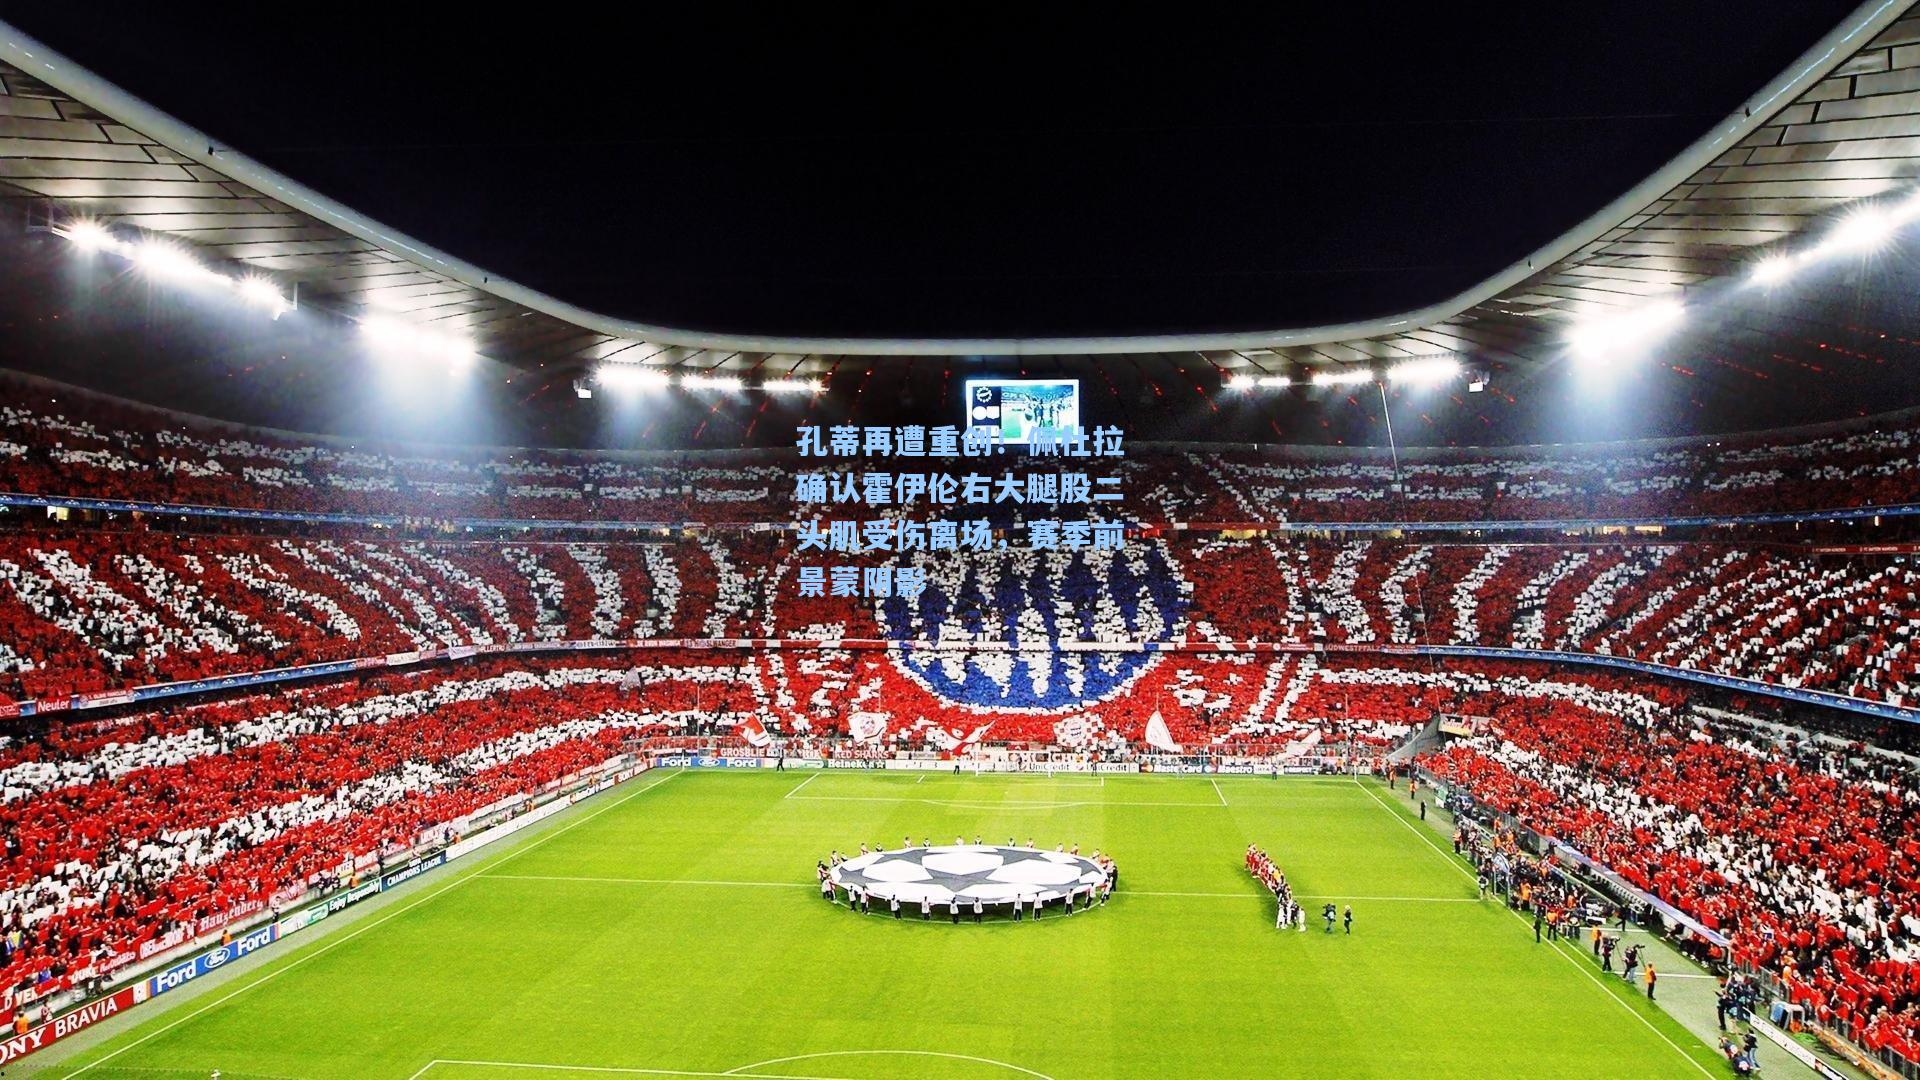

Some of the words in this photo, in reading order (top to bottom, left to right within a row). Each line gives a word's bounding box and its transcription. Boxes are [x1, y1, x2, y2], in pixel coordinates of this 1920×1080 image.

[726, 757, 757, 768] Ford
[854, 750, 889, 760] SHARKS
[1086, 764, 1127, 772] UCredit
[420, 855, 442, 871] LEAGUE
[236, 927, 271, 956] Ford
[157, 960, 197, 994] Ford
[54, 997, 118, 1039] BRAVIA
